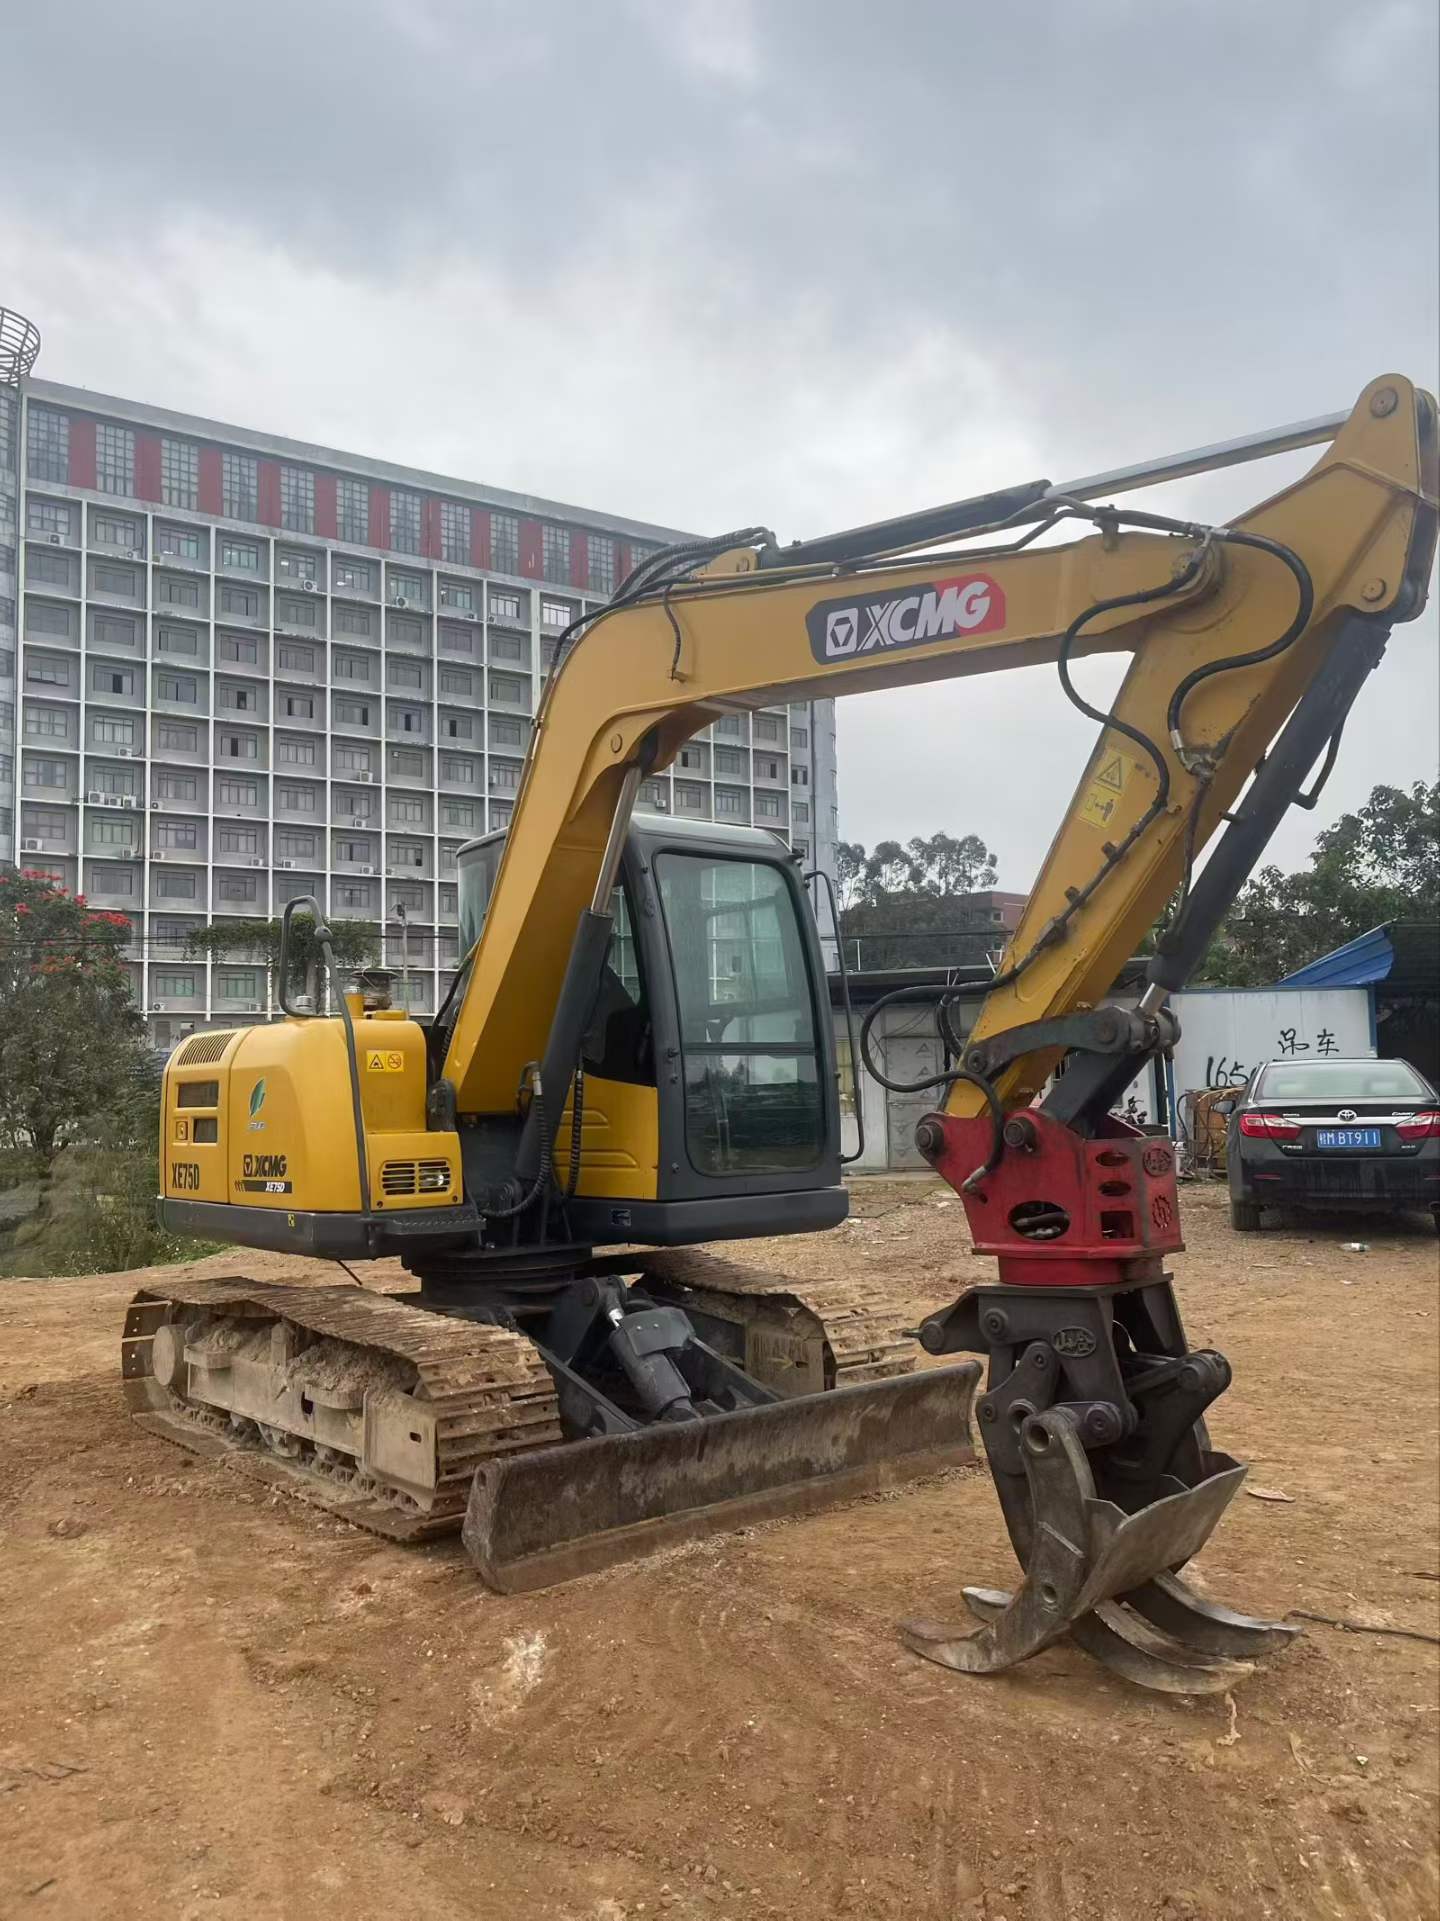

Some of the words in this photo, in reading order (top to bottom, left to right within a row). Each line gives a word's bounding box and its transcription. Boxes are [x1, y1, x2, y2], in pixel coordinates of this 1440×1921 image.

[857, 581, 990, 651] XCMG
[1278, 1028, 1339, 1056] 吊车
[172, 1162, 200, 1191] XE75D
[254, 1154, 287, 1178] XCMG
[265, 1181, 286, 1193] XE75D
